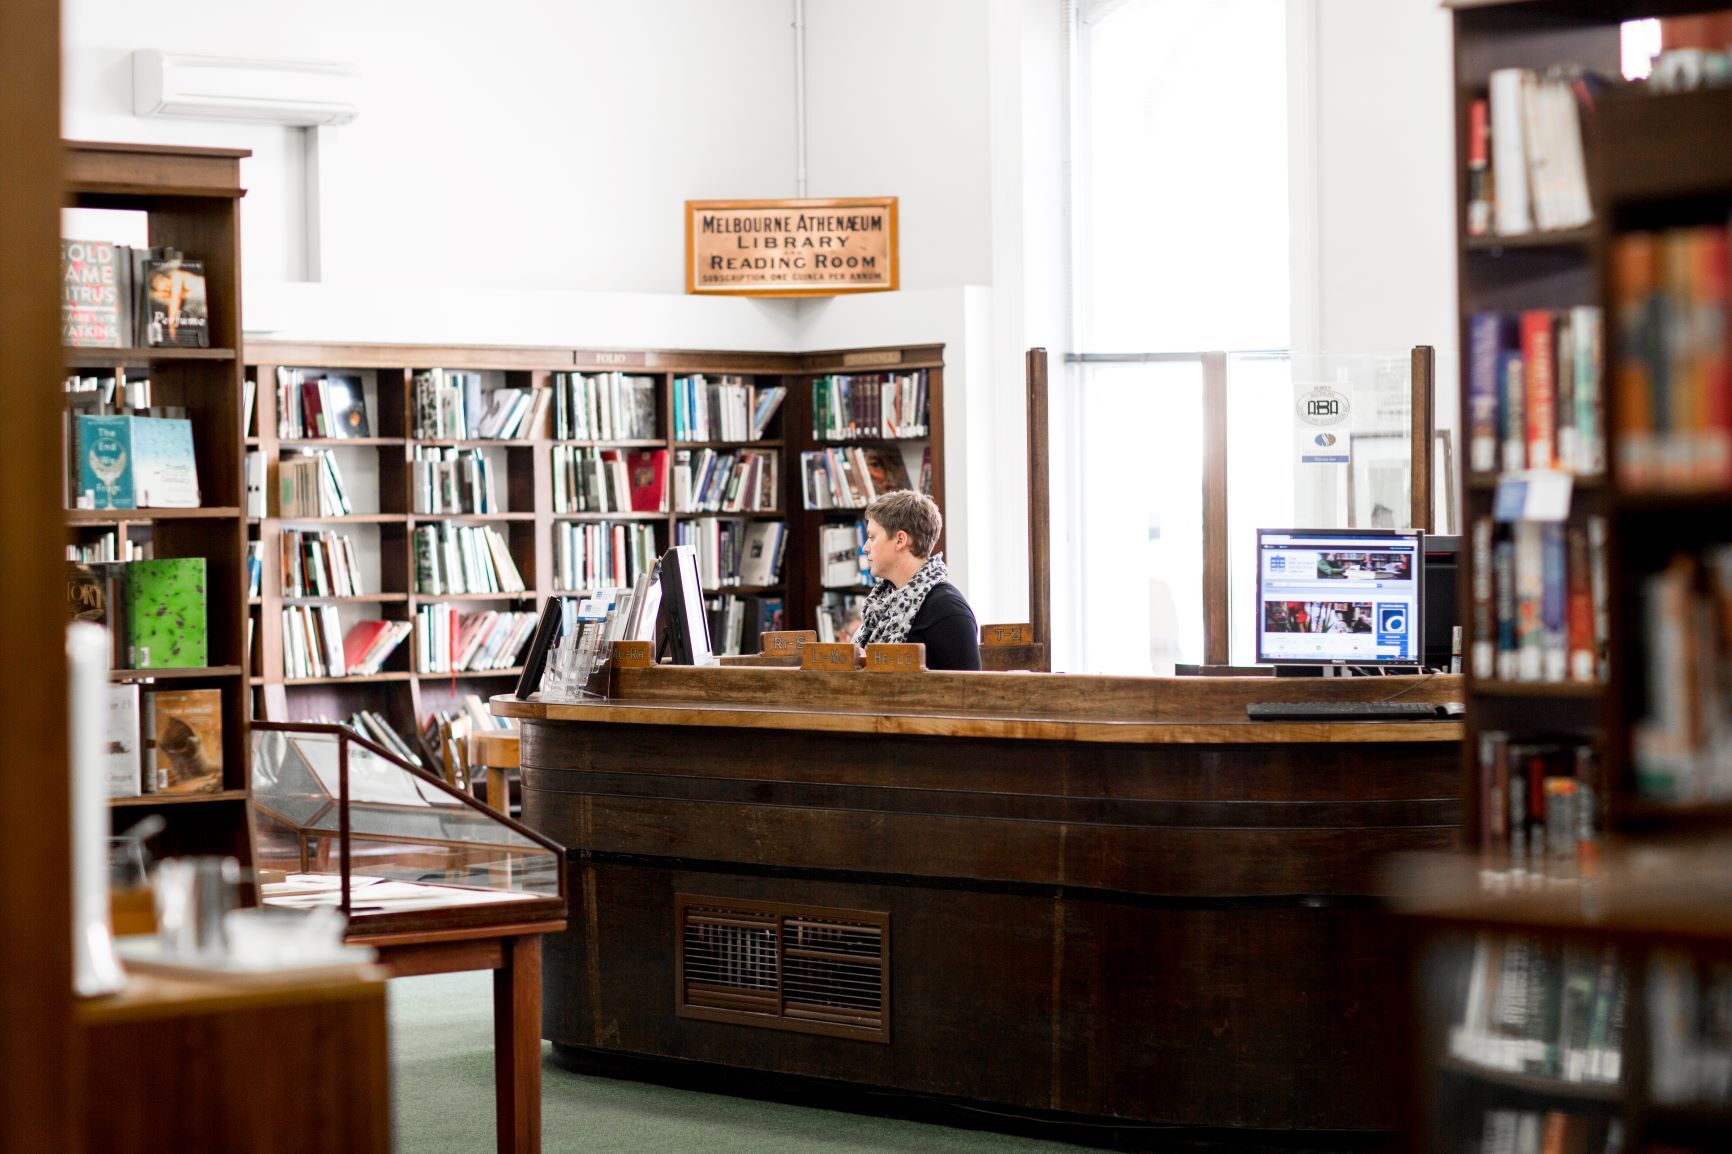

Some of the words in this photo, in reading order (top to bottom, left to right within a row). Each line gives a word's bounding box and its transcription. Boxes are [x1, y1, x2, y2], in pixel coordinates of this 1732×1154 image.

[702, 215, 792, 234] MELBOURNE
[737, 236, 850, 249] LIBRARY
[63, 242, 113, 263] OLD
[710, 255, 806, 270] READING
[815, 254, 876, 269] ROOM
[702, 274, 765, 283] SUBSCRIPTION
[792, 273, 825, 281] GUINEA
[850, 272, 882, 281] ANNUM
[595, 352, 627, 364] FOLIO
[995, 626, 1021, 642] T-Z
